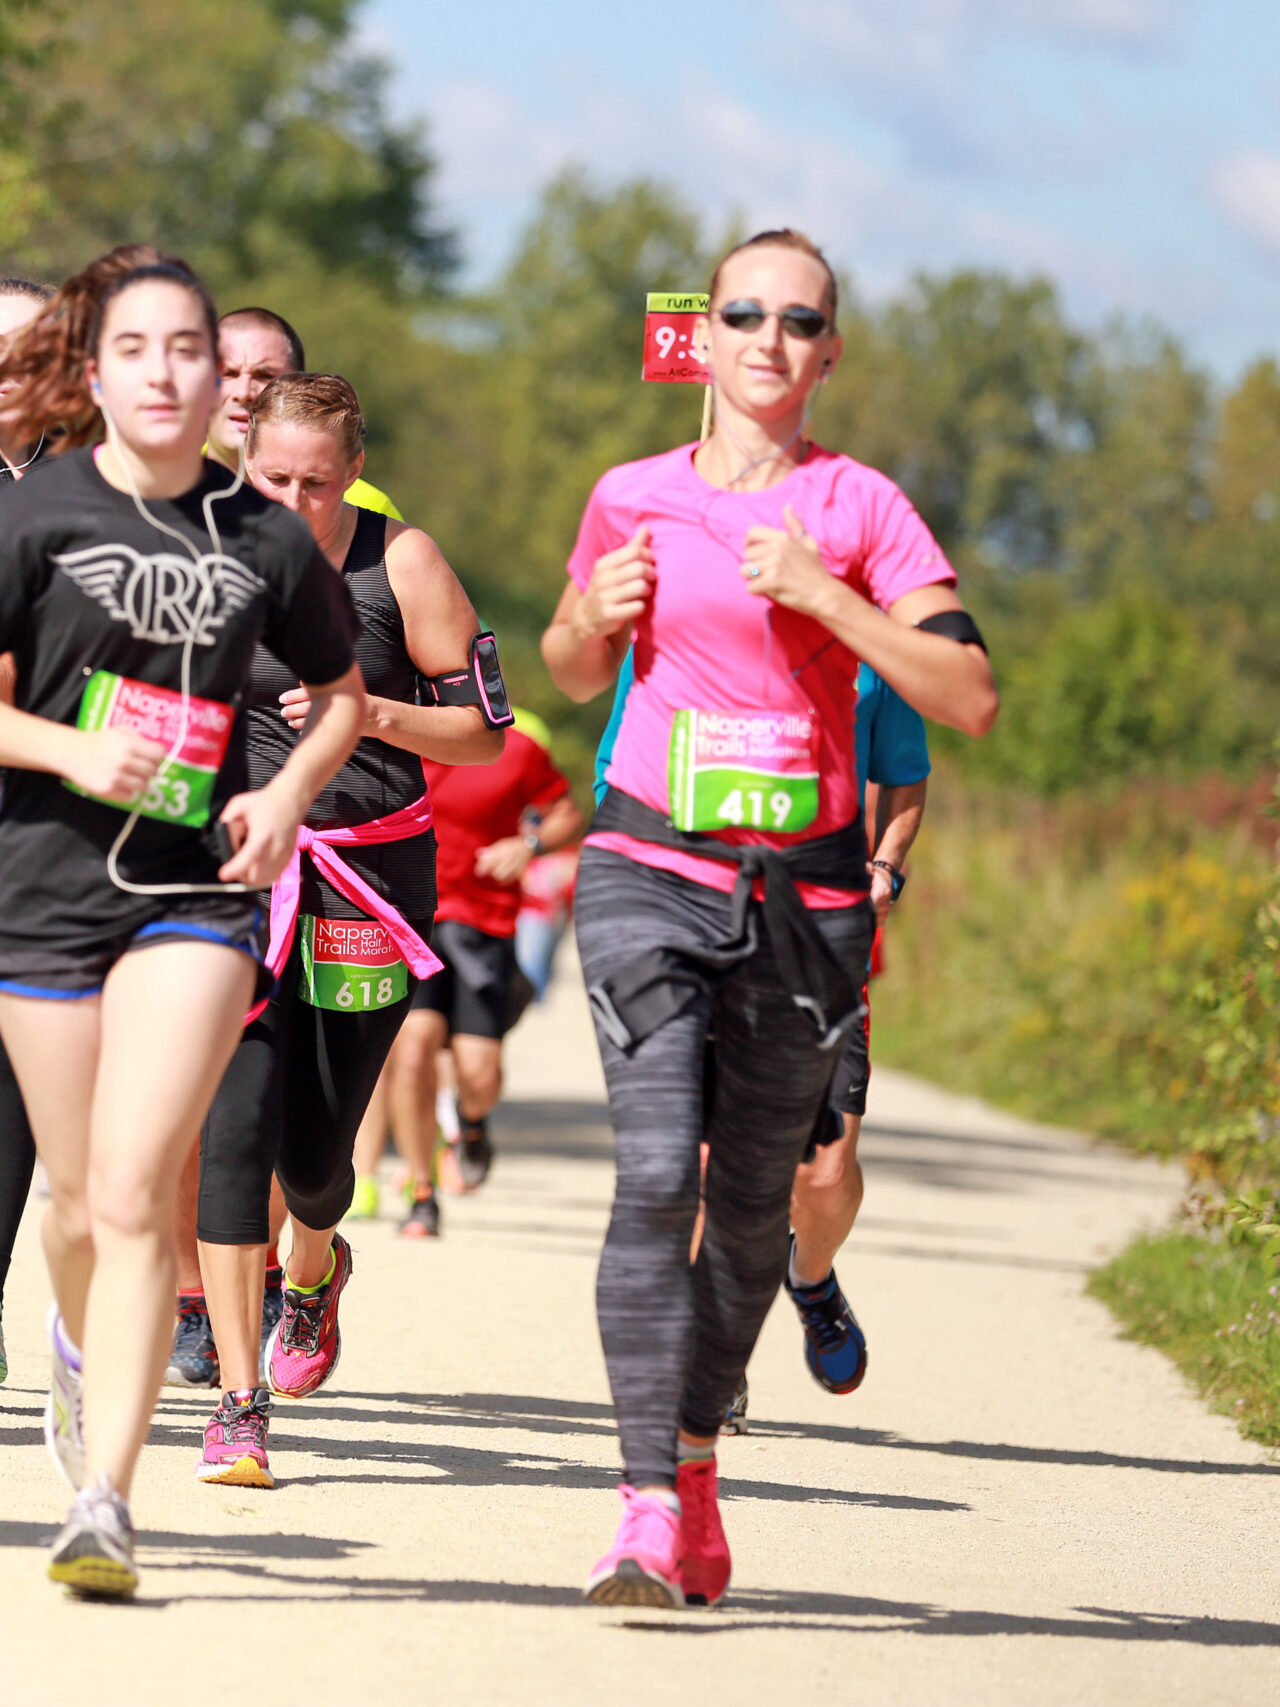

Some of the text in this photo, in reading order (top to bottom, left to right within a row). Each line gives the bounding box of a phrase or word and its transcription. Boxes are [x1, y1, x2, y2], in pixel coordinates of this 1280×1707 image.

[667, 298, 692, 309] run
[120, 685, 229, 732] Napeville
[697, 714, 812, 739] Naperville
[696, 734, 747, 757] Trails
[716, 789, 793, 828] 419
[316, 937, 358, 956] Trails
[360, 938, 382, 948] Half
[335, 977, 393, 1007] 618
